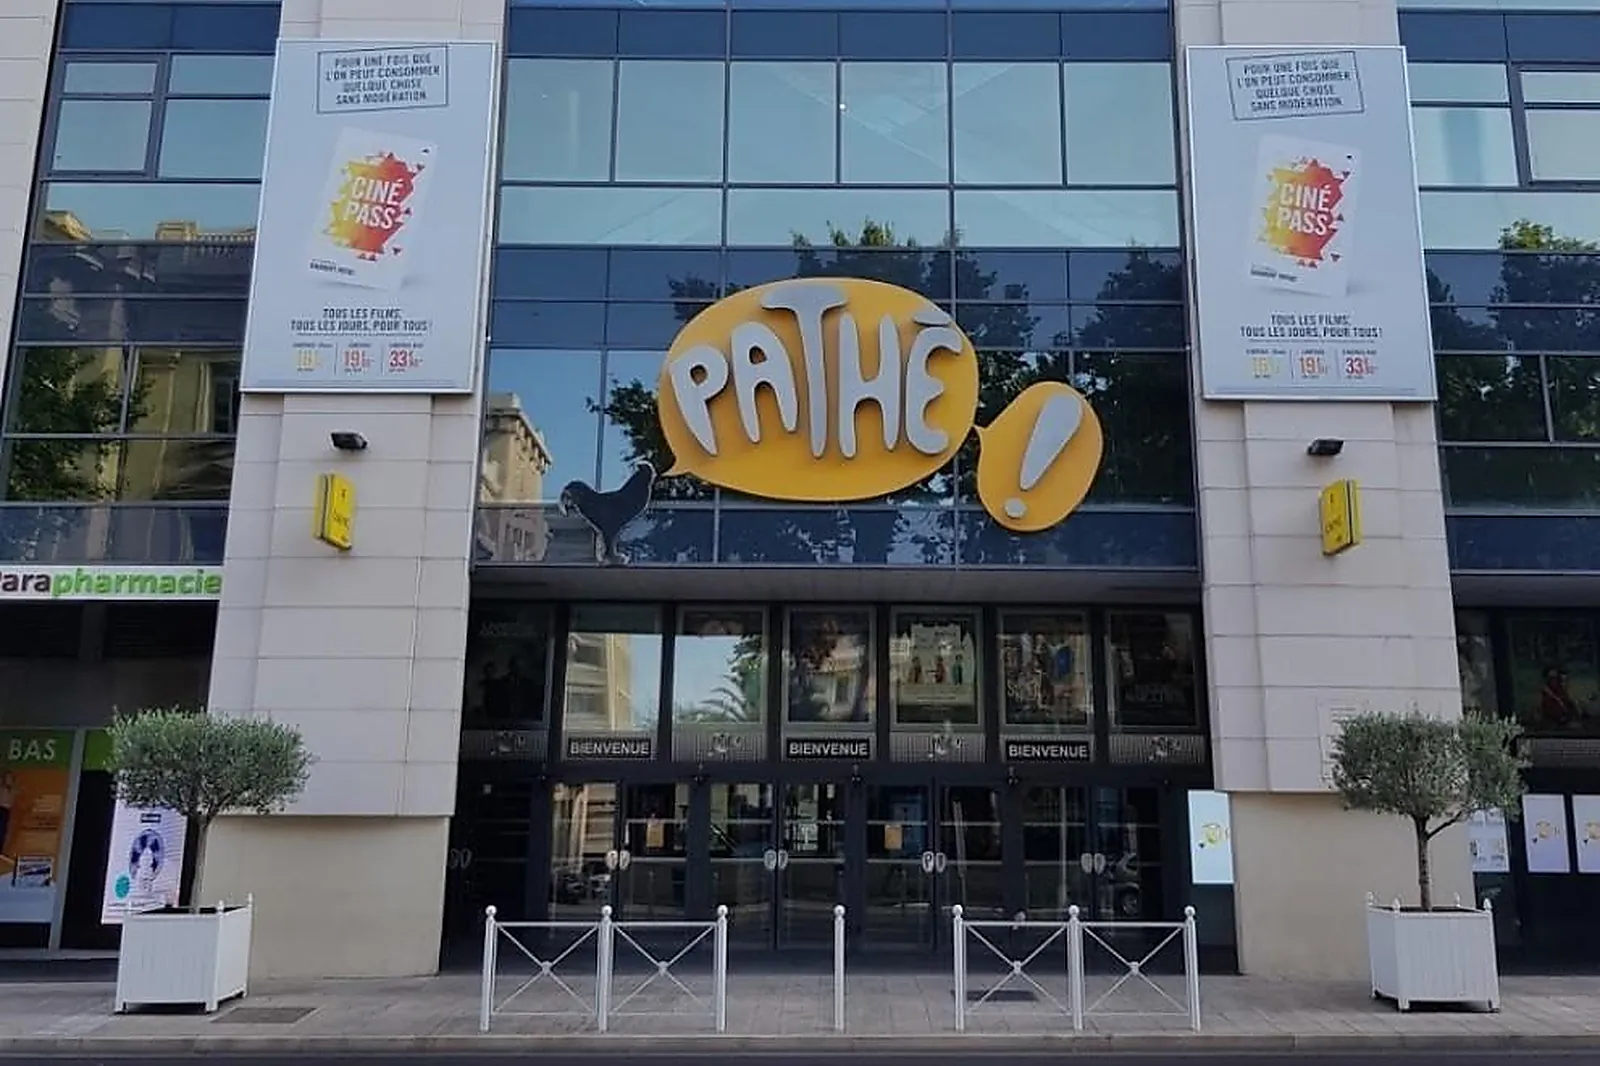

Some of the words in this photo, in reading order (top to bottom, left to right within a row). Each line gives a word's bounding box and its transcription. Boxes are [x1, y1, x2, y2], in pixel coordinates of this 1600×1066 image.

[352, 176, 403, 206] CINÉ
[1280, 183, 1331, 211] CINÉ
[343, 201, 396, 230] PASS
[1278, 207, 1328, 236] PASS
[291, 320, 315, 331] TOUS
[319, 320, 336, 331] LES
[373, 320, 400, 331] POUR
[323, 308, 348, 319] TOUS
[350, 308, 368, 319] LES
[1270, 314, 1296, 325] TOUS
[1298, 314, 1317, 325] LES
[1240, 327, 1265, 337] TOUS
[1268, 327, 1285, 337] LES
[1323, 327, 1350, 337] POUR
[669, 283, 963, 459] PATHÉ
[0, 567, 221, 597] arapharmacie
[8, 738, 57, 760] BAS
[570, 741, 650, 755] BIENVENUE
[789, 742, 868, 756] BIENVENUE
[1008, 744, 1088, 758] BIENVENUE
